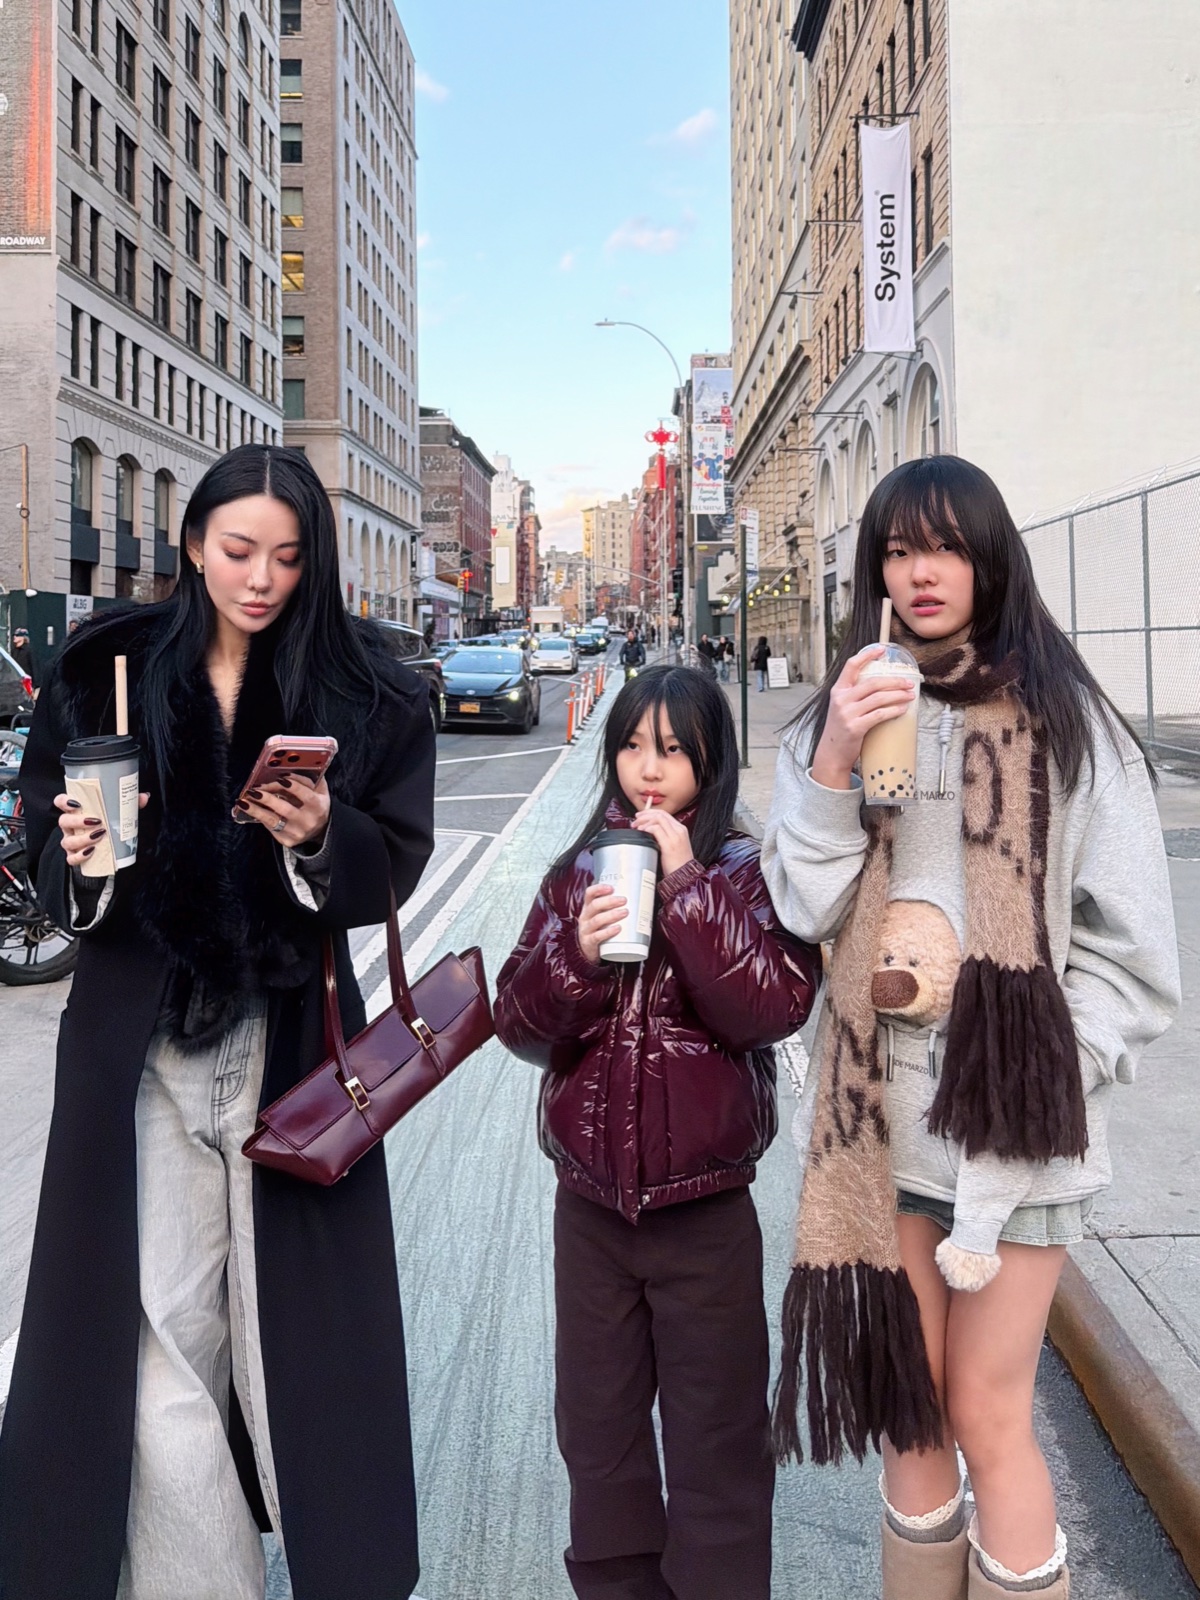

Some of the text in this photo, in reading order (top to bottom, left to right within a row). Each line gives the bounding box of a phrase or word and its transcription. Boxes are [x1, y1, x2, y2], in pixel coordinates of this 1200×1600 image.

[0, 236, 46, 246] ROADWAY
[875, 194, 900, 302] System
[920, 791, 955, 800] MARZO
[601, 873, 624, 881] EYTEA
[904, 1062, 929, 1074] MARZO
